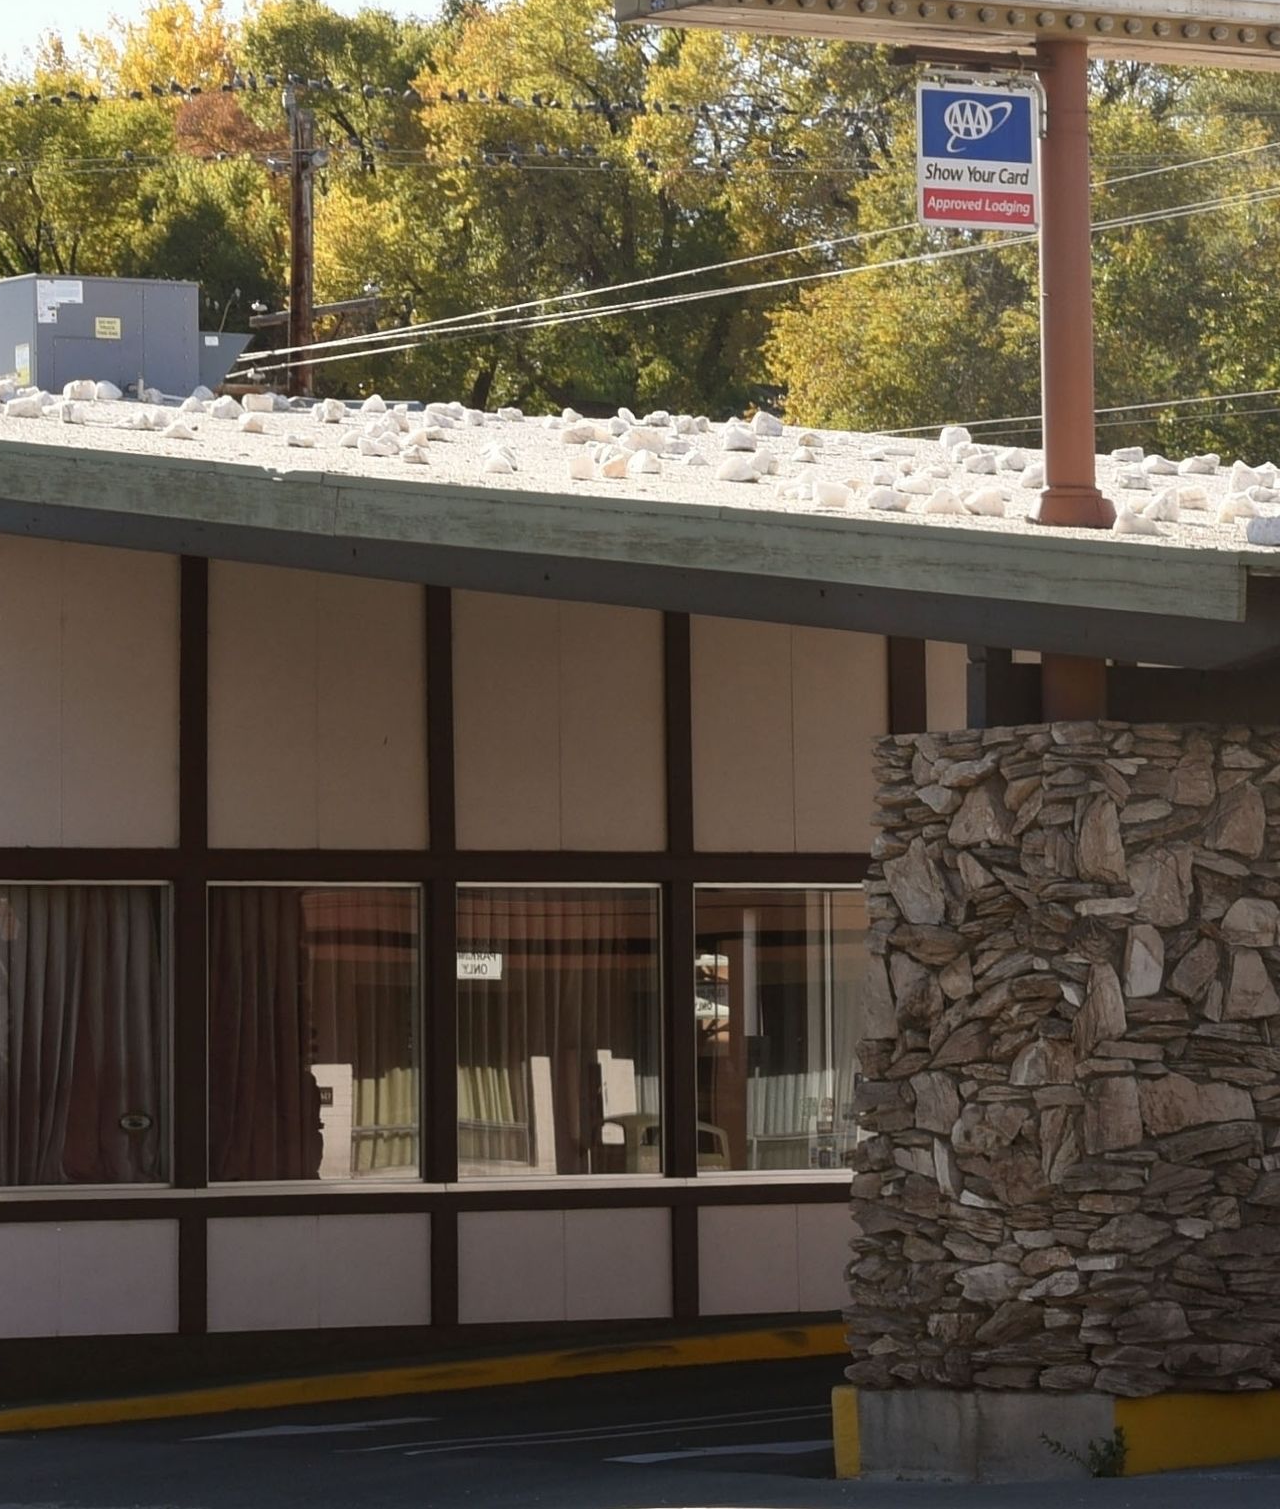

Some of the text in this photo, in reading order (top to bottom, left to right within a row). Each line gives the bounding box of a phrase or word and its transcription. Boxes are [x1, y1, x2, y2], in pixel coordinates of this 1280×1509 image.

[947, 100, 990, 139] AAA
[925, 163, 1029, 185] Show Your Card
[927, 195, 1031, 216] Approved Lodging
